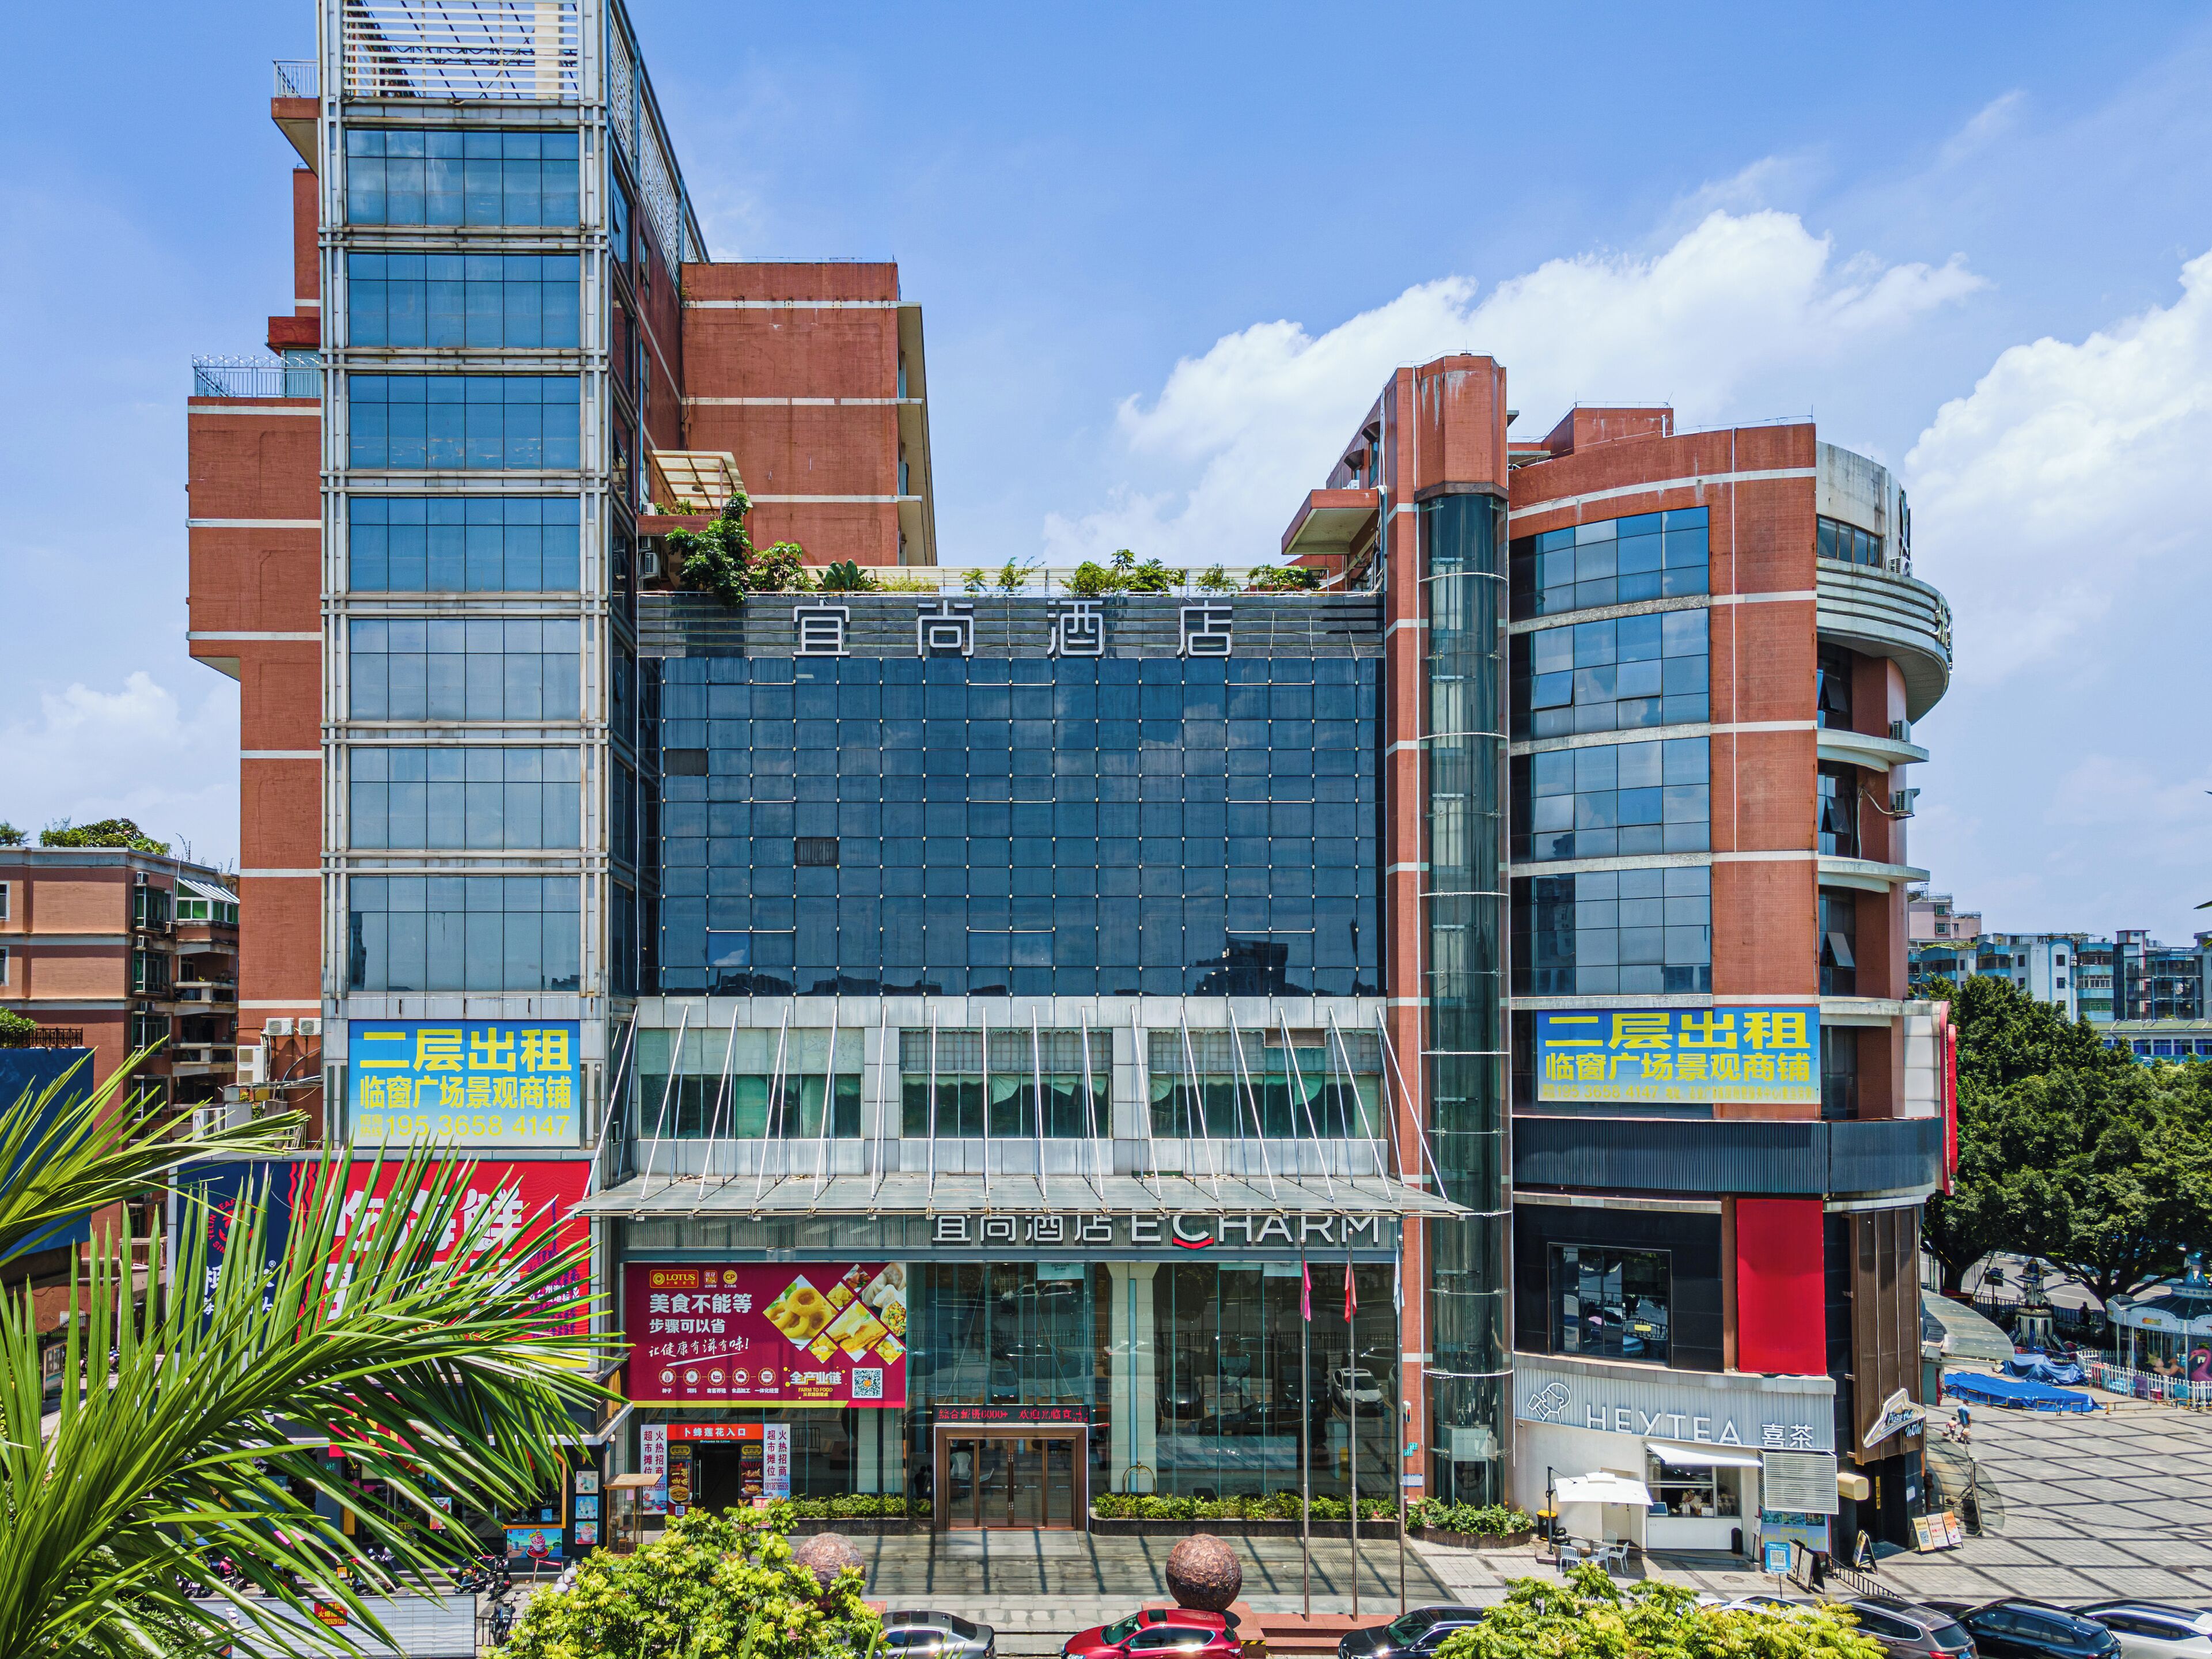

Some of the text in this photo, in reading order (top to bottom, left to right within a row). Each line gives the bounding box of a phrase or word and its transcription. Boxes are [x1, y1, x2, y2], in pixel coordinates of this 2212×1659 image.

[793, 599, 1233, 657] 宜尚酒店
[1545, 1011, 1810, 1050] 二层出租
[360, 1028, 571, 1072] 二层出租
[1545, 1052, 1810, 1082] 临窗广场景观商铺
[360, 1075, 571, 1109] 临窗广场景观商铺
[1557, 1085, 1580, 1098] 195
[1584, 1085, 1620, 1099] 3658
[1626, 1085, 1659, 1098] 4147
[387, 1115, 570, 1137] 195 3658 4147
[932, 1209, 1378, 1243] 宜尚酒店 ECHARM
[650, 1294, 752, 1313] 美食不能等
[649, 1319, 726, 1334] 步骤可以省
[790, 1371, 842, 1384] 全产业链
[1586, 1404, 1743, 1445] HEYTEA
[1760, 1423, 1813, 1448] 喜茶
[767, 1430, 776, 1476] 超市摊位
[778, 1430, 787, 1476] 火热招商
